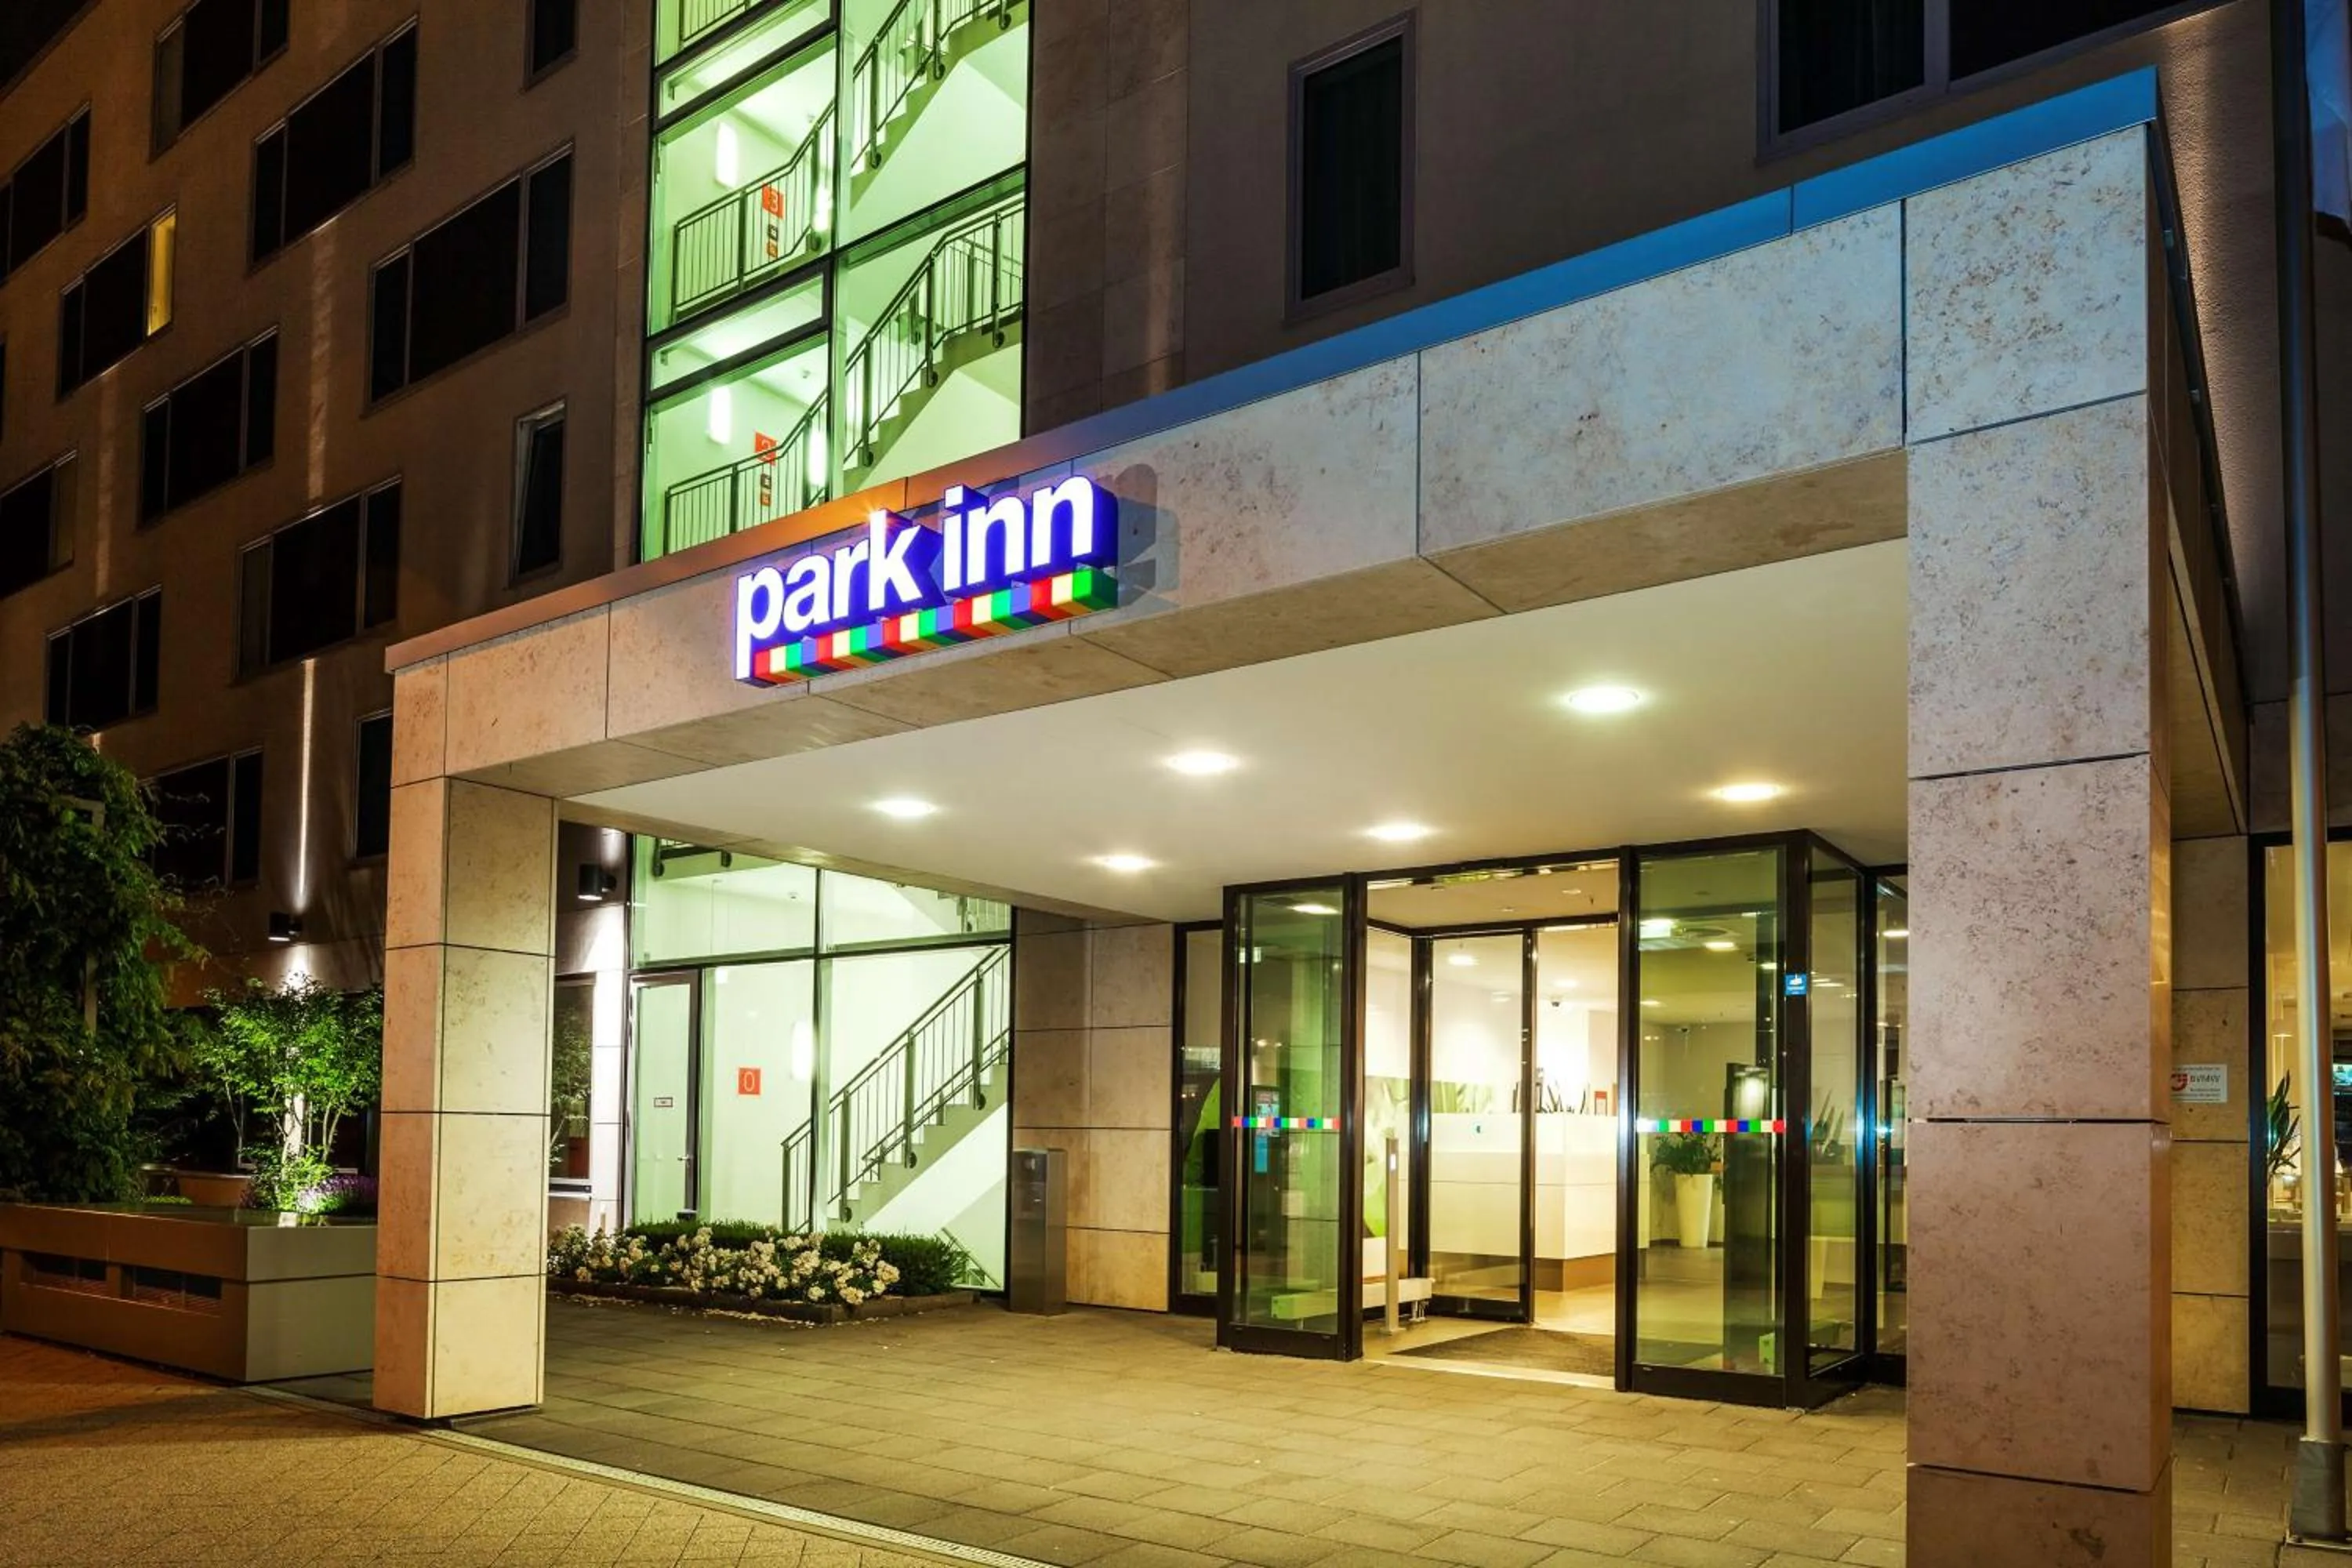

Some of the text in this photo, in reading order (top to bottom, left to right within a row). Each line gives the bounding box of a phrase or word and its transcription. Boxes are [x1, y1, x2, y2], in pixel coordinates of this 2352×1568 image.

[769, 190, 779, 213] 3
[735, 475, 1094, 681] park inn
[744, 1070, 755, 1092] 0
